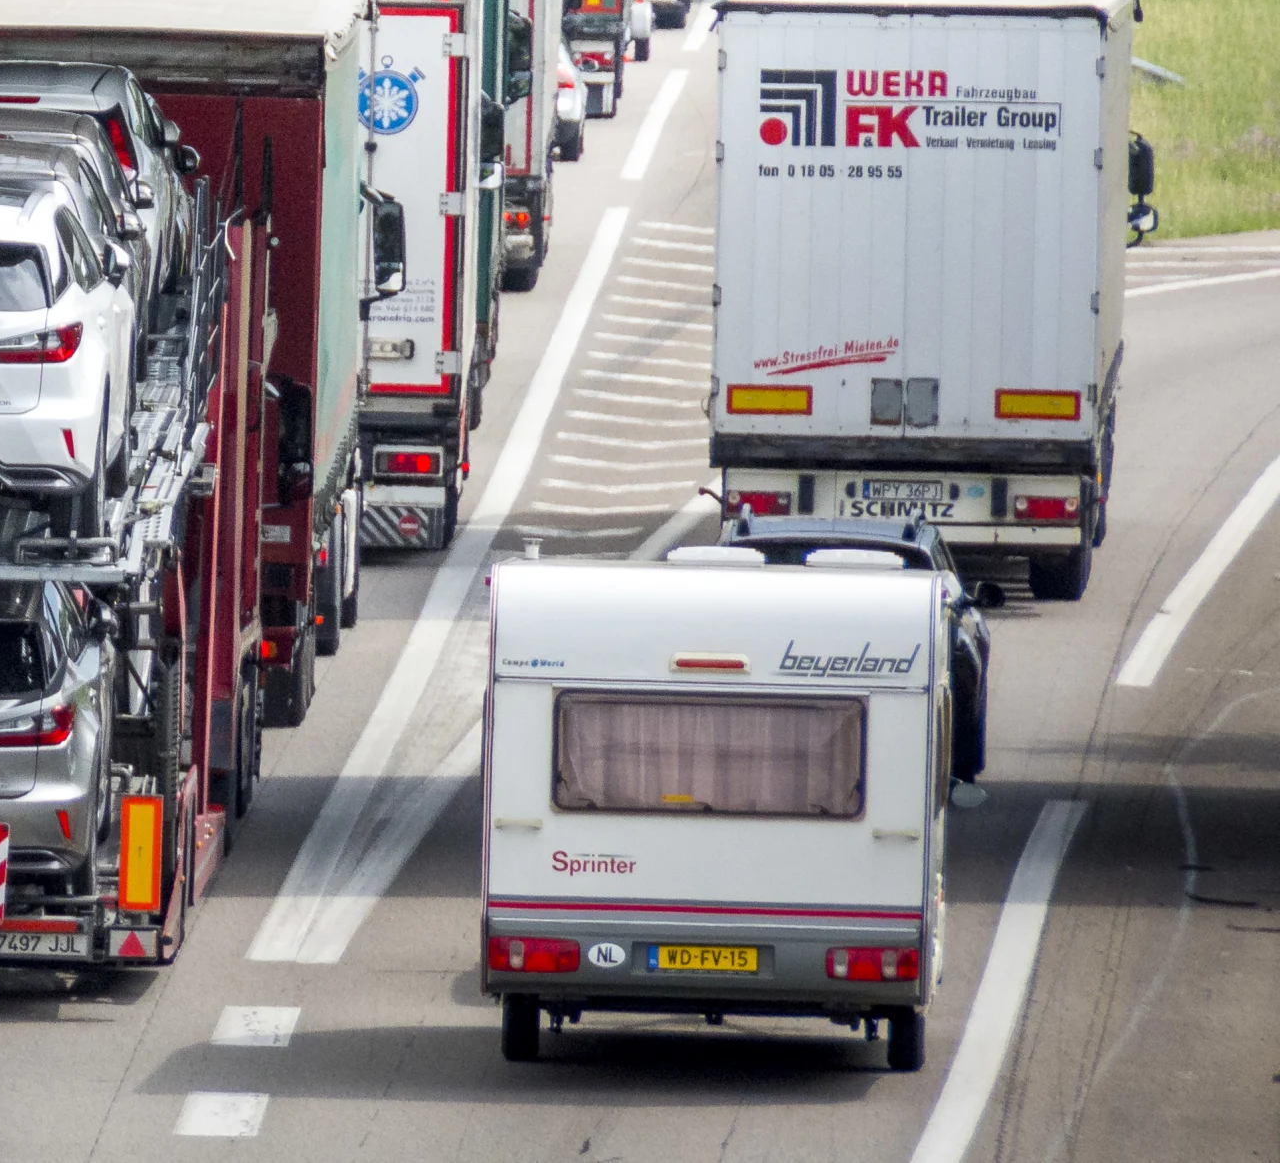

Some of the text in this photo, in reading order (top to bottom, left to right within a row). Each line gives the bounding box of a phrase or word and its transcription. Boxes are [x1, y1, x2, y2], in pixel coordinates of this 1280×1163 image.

[846, 69, 948, 97] WEKA
[955, 86, 1038, 101] Fahrzeugbau
[922, 105, 1057, 132] Trailer Group
[758, 164, 779, 177] fon
[801, 165, 815, 177] 18
[820, 165, 835, 177] 05
[847, 165, 863, 177] 28
[867, 165, 883, 178] 95
[887, 165, 903, 178] 55
[778, 639, 922, 677] beyerland
[552, 850, 637, 876] Sprinter
[48, 936, 81, 953] JJL
[596, 946, 618, 963] NL
[667, 949, 749, 967] WD-FV-15
